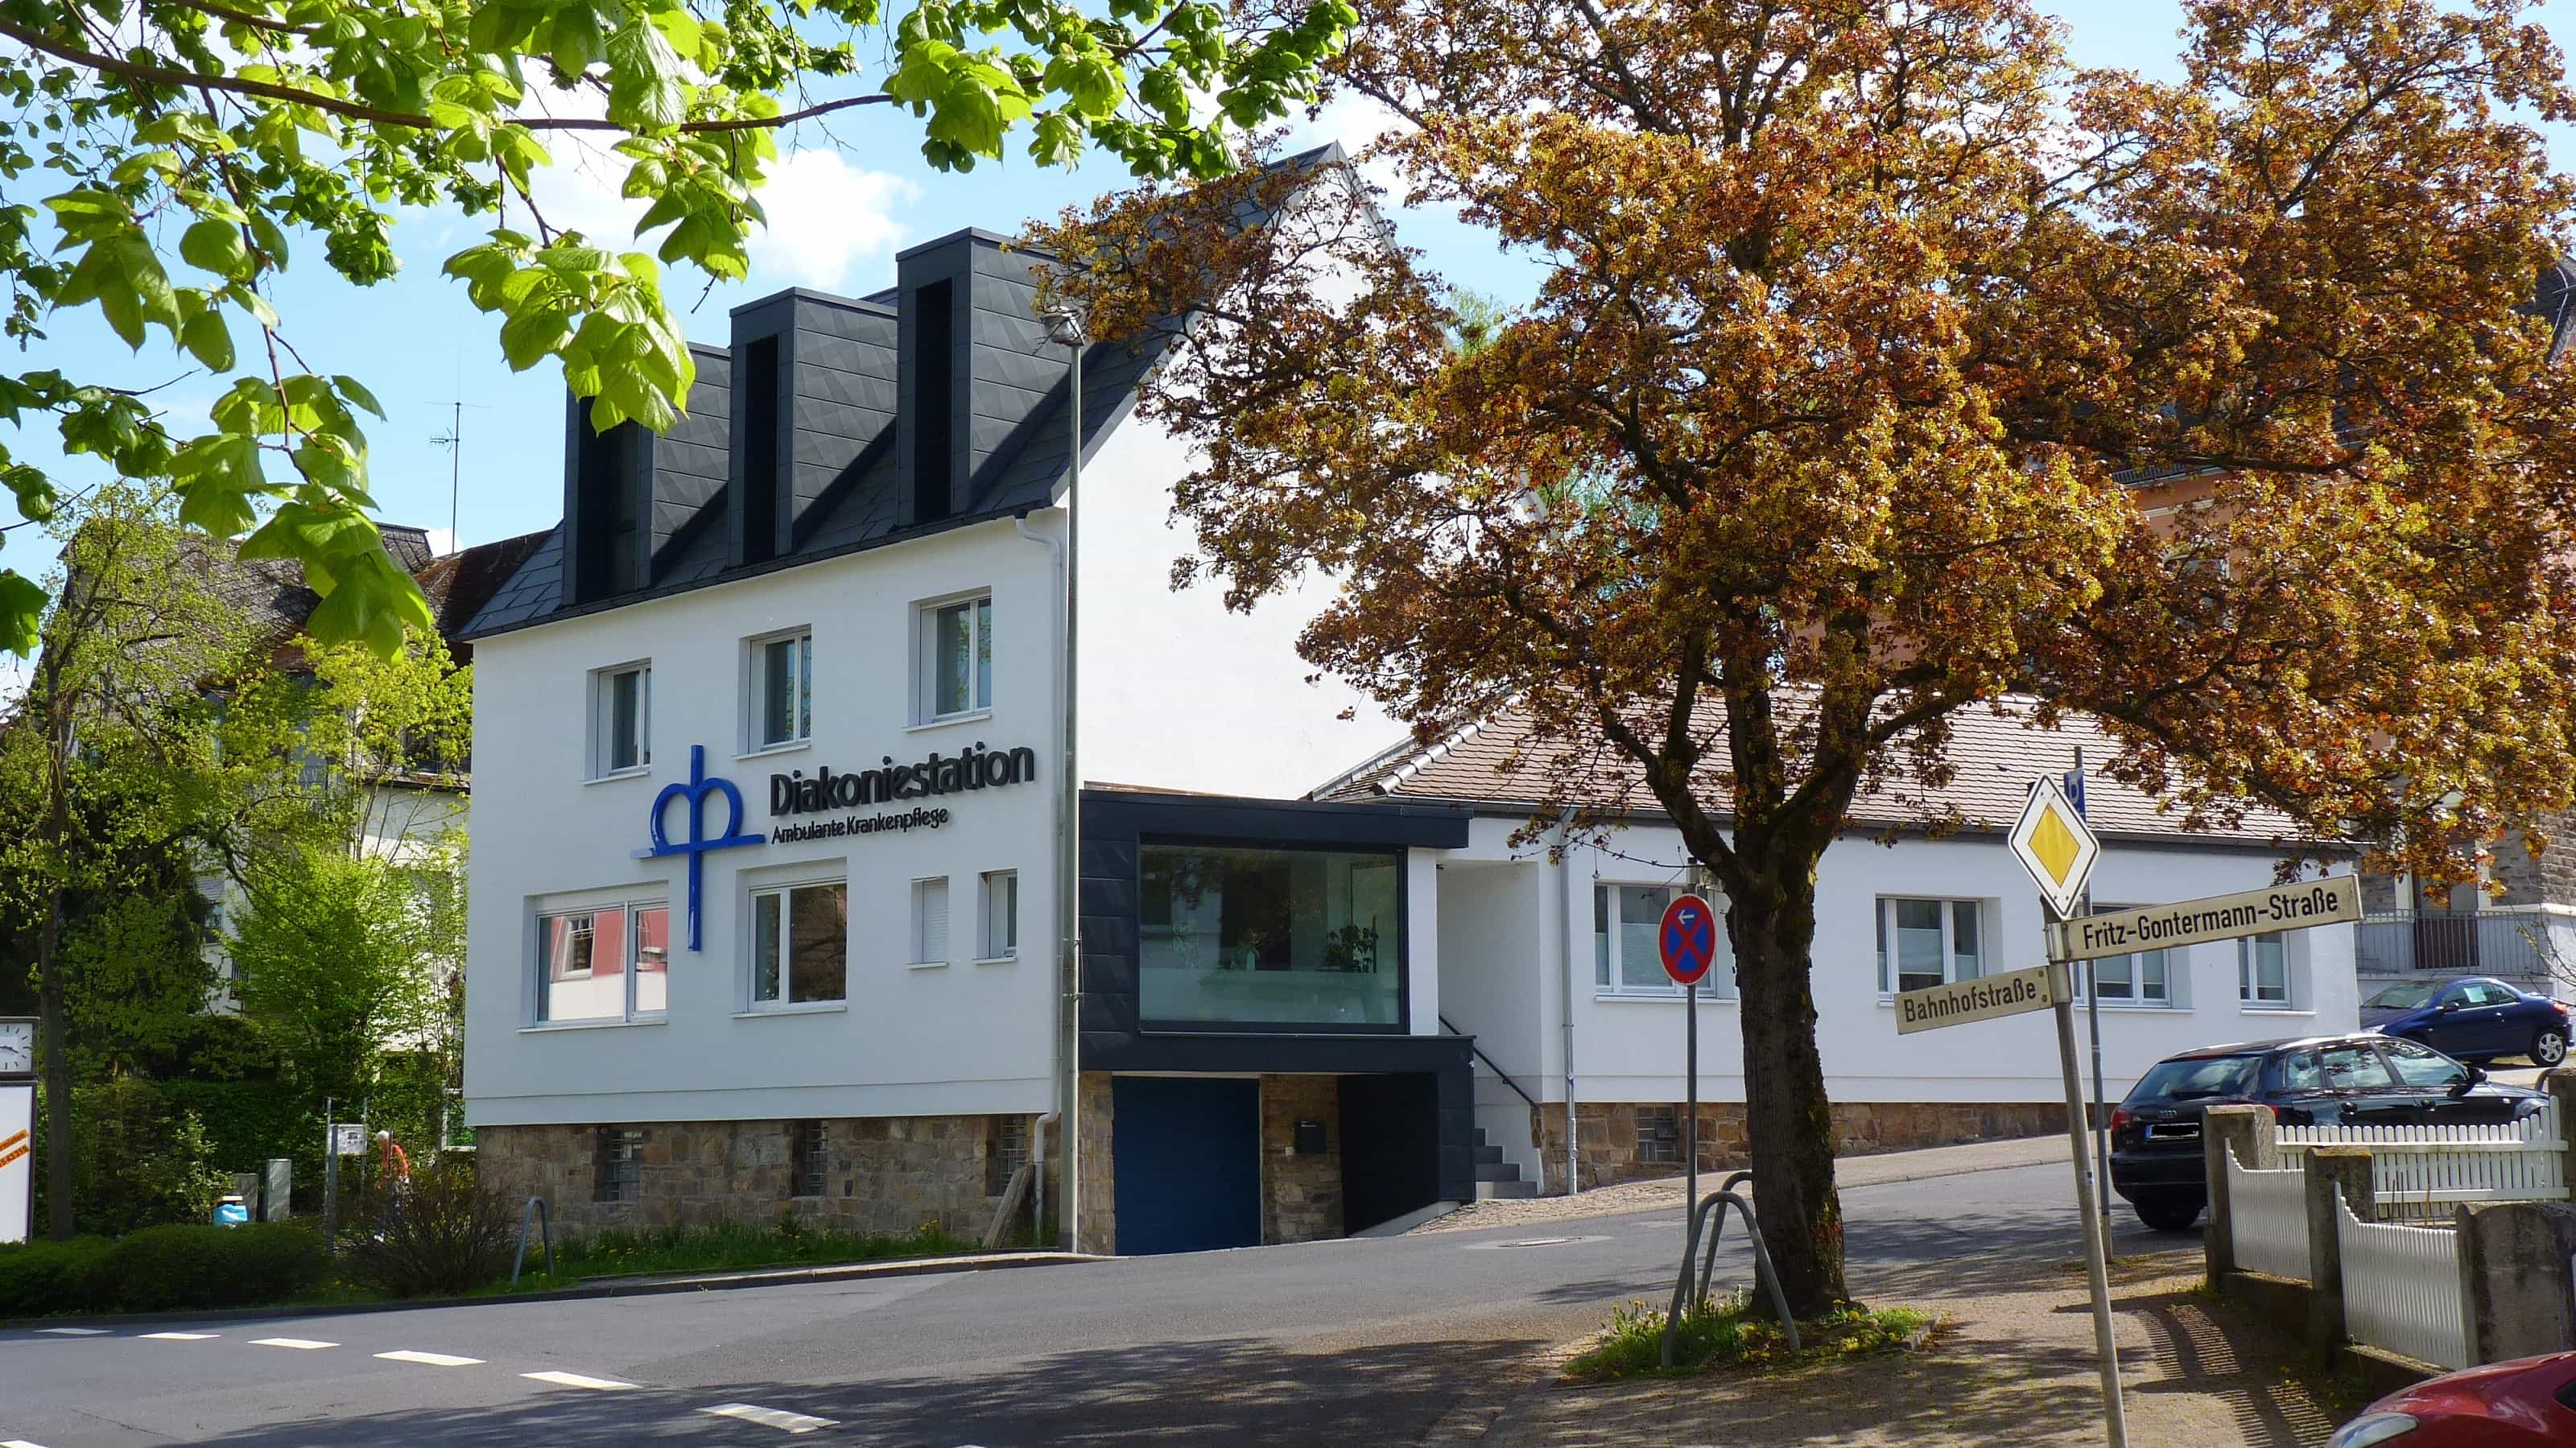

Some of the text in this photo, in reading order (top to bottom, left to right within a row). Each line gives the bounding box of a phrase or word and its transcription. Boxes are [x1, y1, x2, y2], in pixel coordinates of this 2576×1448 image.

[770, 741, 1034, 816] Diakoniestation
[771, 807, 949, 844] Ambulante Krankenpflege
[2083, 886, 2339, 950] Fritz-Gontermann-Straße
[1903, 977, 2037, 1023] Bahnhofstraße
